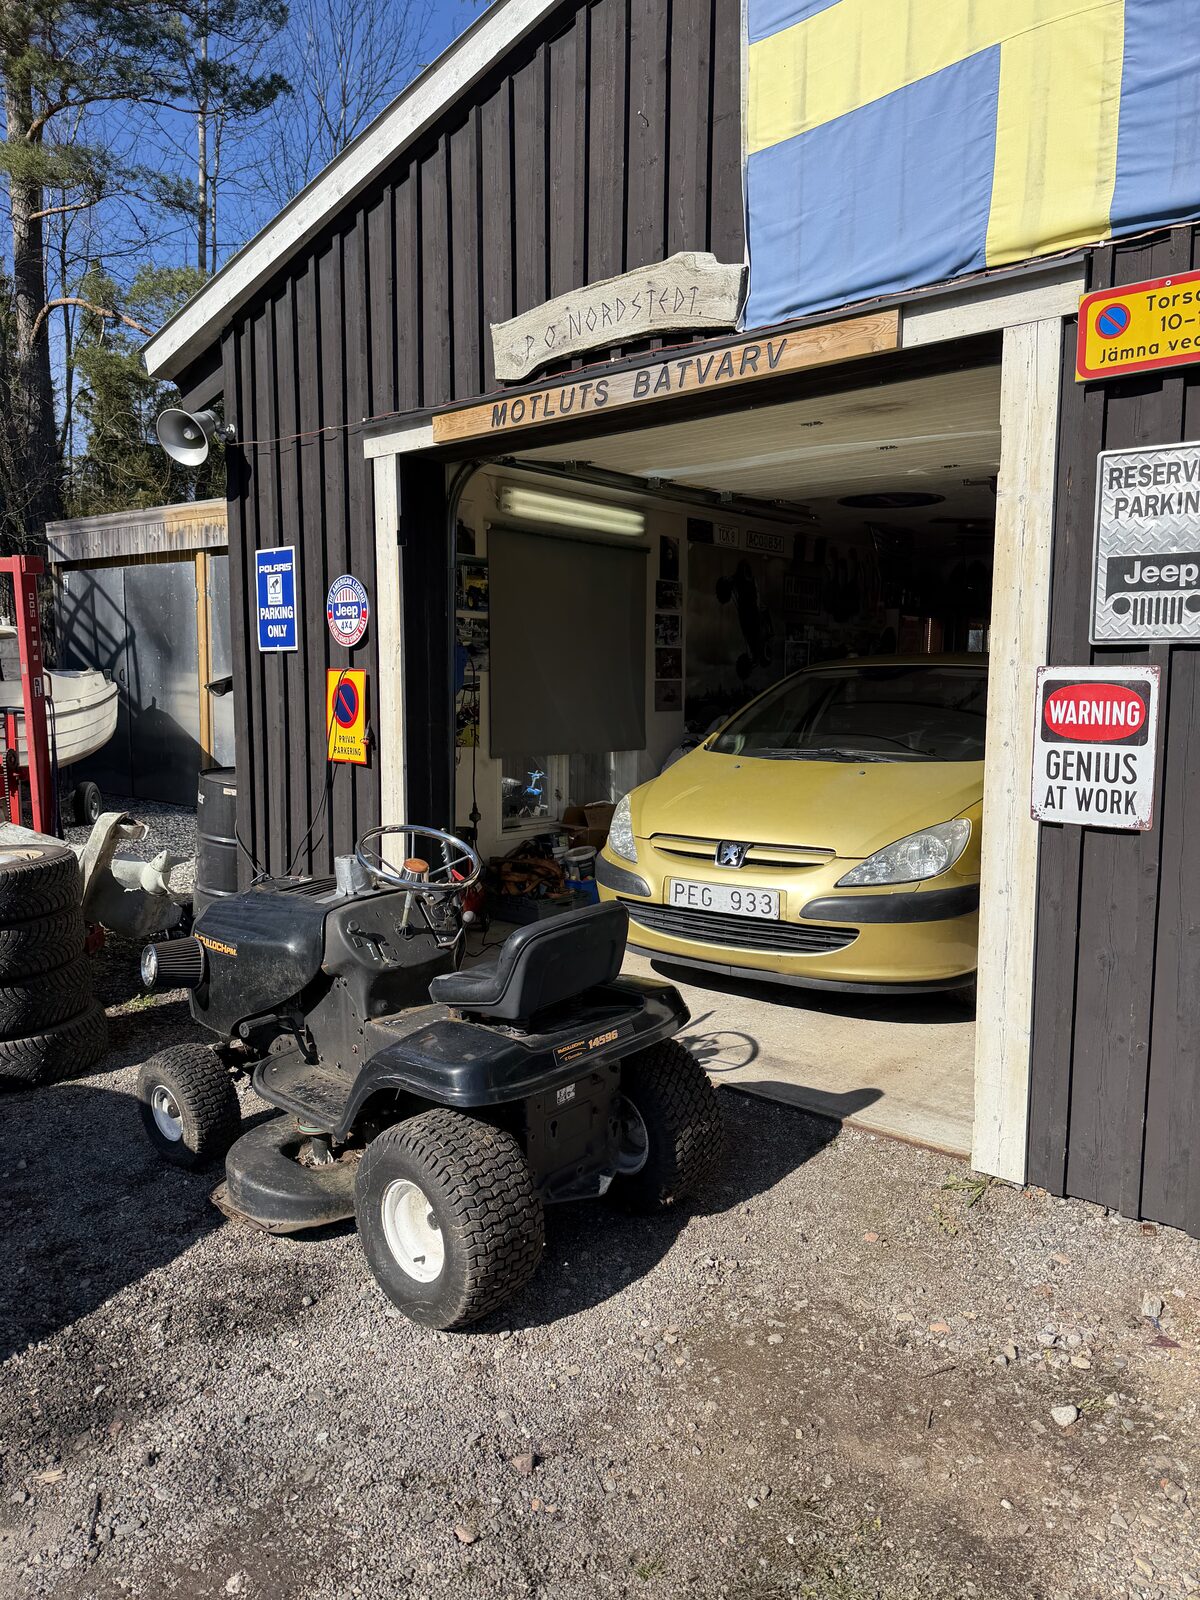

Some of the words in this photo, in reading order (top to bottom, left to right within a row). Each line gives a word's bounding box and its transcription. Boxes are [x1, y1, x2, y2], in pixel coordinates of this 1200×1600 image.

[1100, 342, 1160, 364] Jämna
[491, 380, 609, 428] MOTLUTS
[1108, 459, 1200, 490] RESERV
[259, 563, 292, 574] POLARIS
[1124, 560, 1199, 587] Jeep
[260, 605, 294, 620] PARKING
[336, 604, 358, 619] Jeep
[267, 624, 287, 638] ONLY
[1049, 700, 1140, 727] WARNING
[334, 745, 361, 756] PARKERING
[1046, 749, 1138, 785] GENIUS
[1044, 785, 1067, 810] AT
[1075, 787, 1138, 815] WORK
[674, 883, 712, 906] PEG
[730, 891, 772, 914] 933
[588, 1029, 618, 1050] 14596
